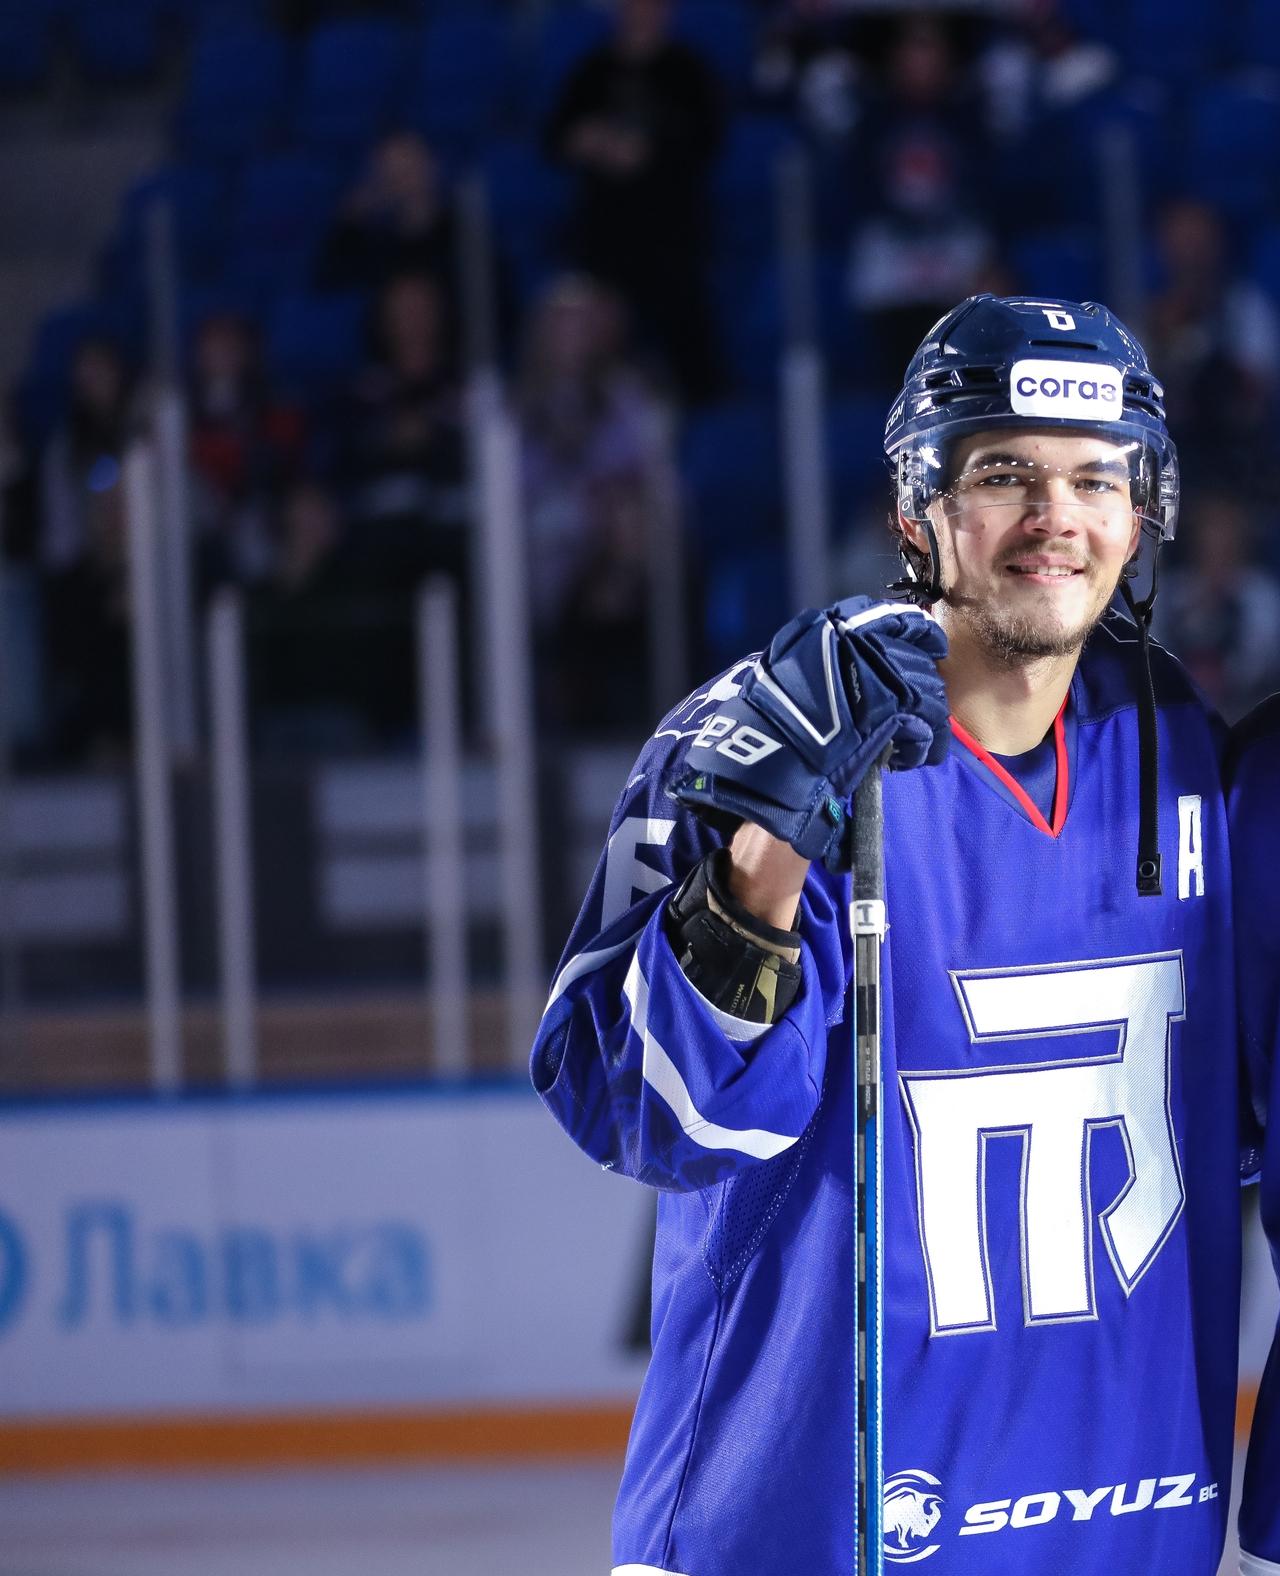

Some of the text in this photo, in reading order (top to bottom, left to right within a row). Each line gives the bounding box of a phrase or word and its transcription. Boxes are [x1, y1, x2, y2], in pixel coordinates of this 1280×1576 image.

[1042, 309, 1076, 331] 6
[1016, 377, 1117, 403] согаз
[1178, 795, 1205, 901] A
[60, 1201, 433, 1326] Лавка
[959, 1473, 1194, 1537] SOYUZ
